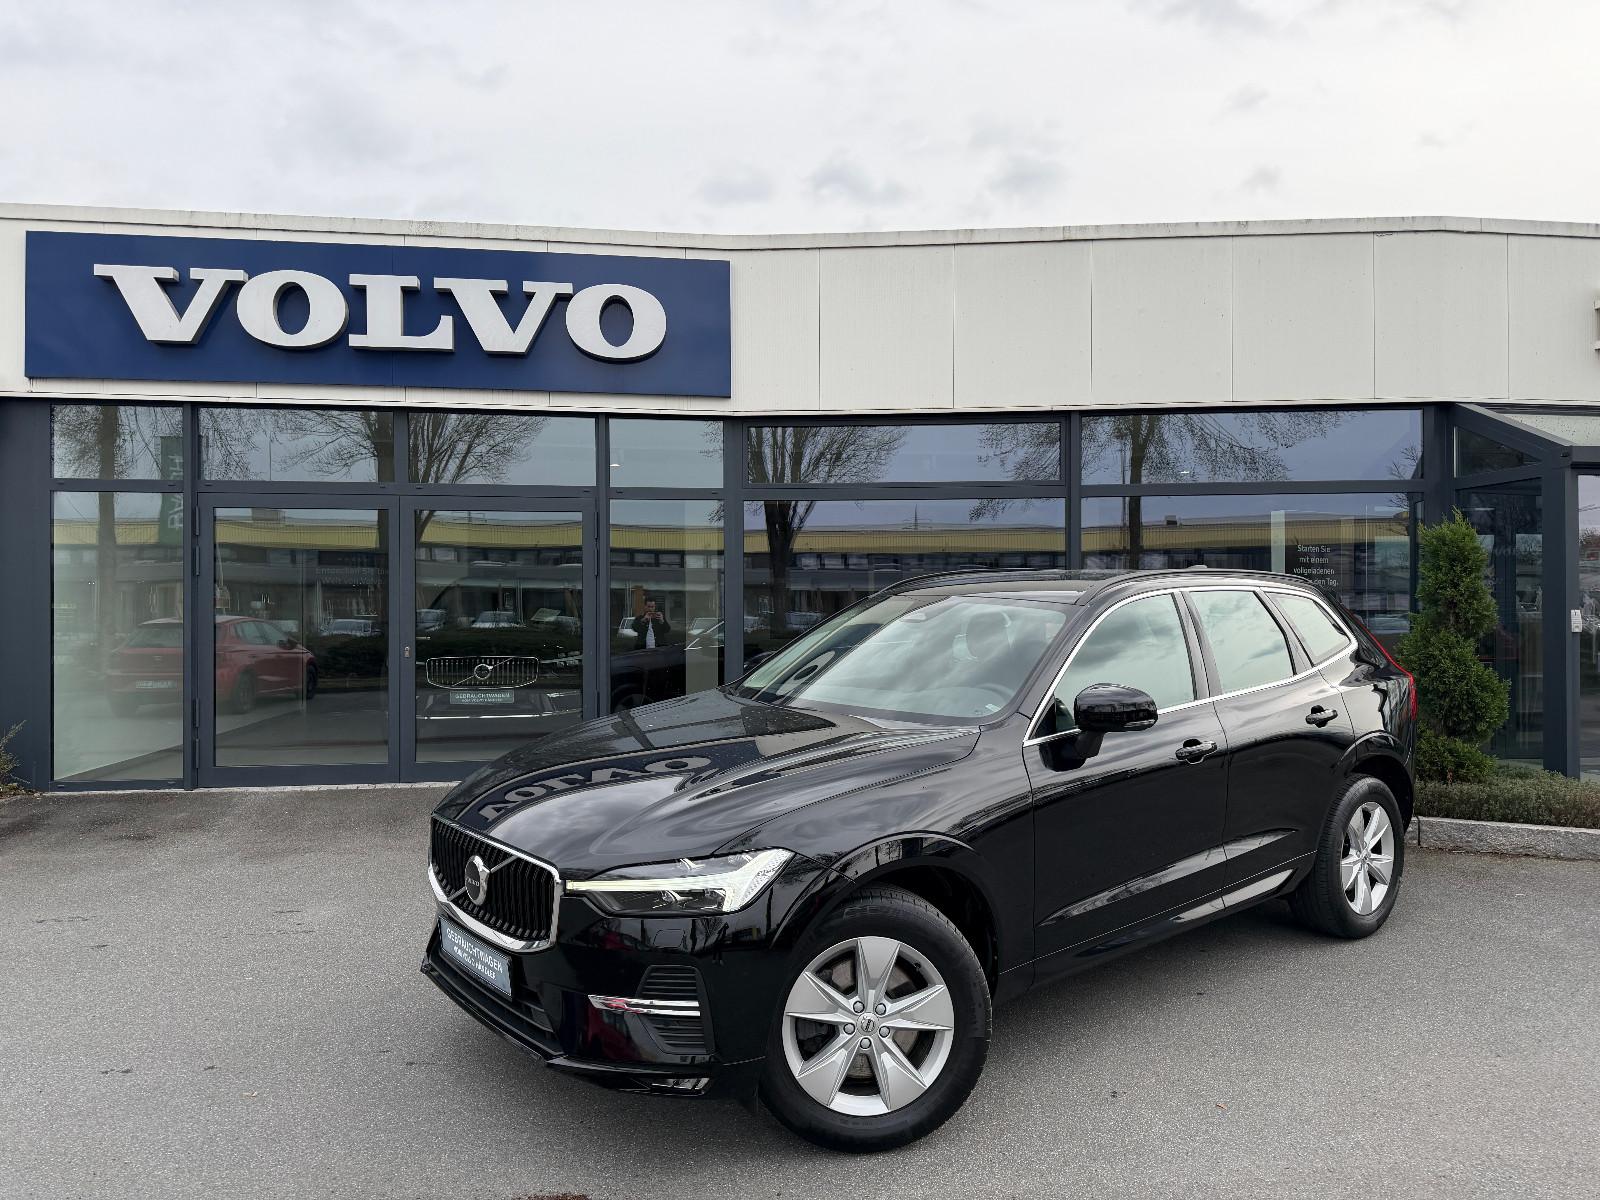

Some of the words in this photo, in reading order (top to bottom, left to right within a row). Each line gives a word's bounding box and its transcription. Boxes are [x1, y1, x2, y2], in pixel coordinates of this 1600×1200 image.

[93, 263, 667, 361] VOLVO
[1297, 544, 1320, 553] Starten
[1320, 545, 1331, 553] Sie
[1299, 555, 1310, 563] mit
[1310, 556, 1329, 564] einem
[446, 927, 503, 974] GEBRAUCHTWAGEN
